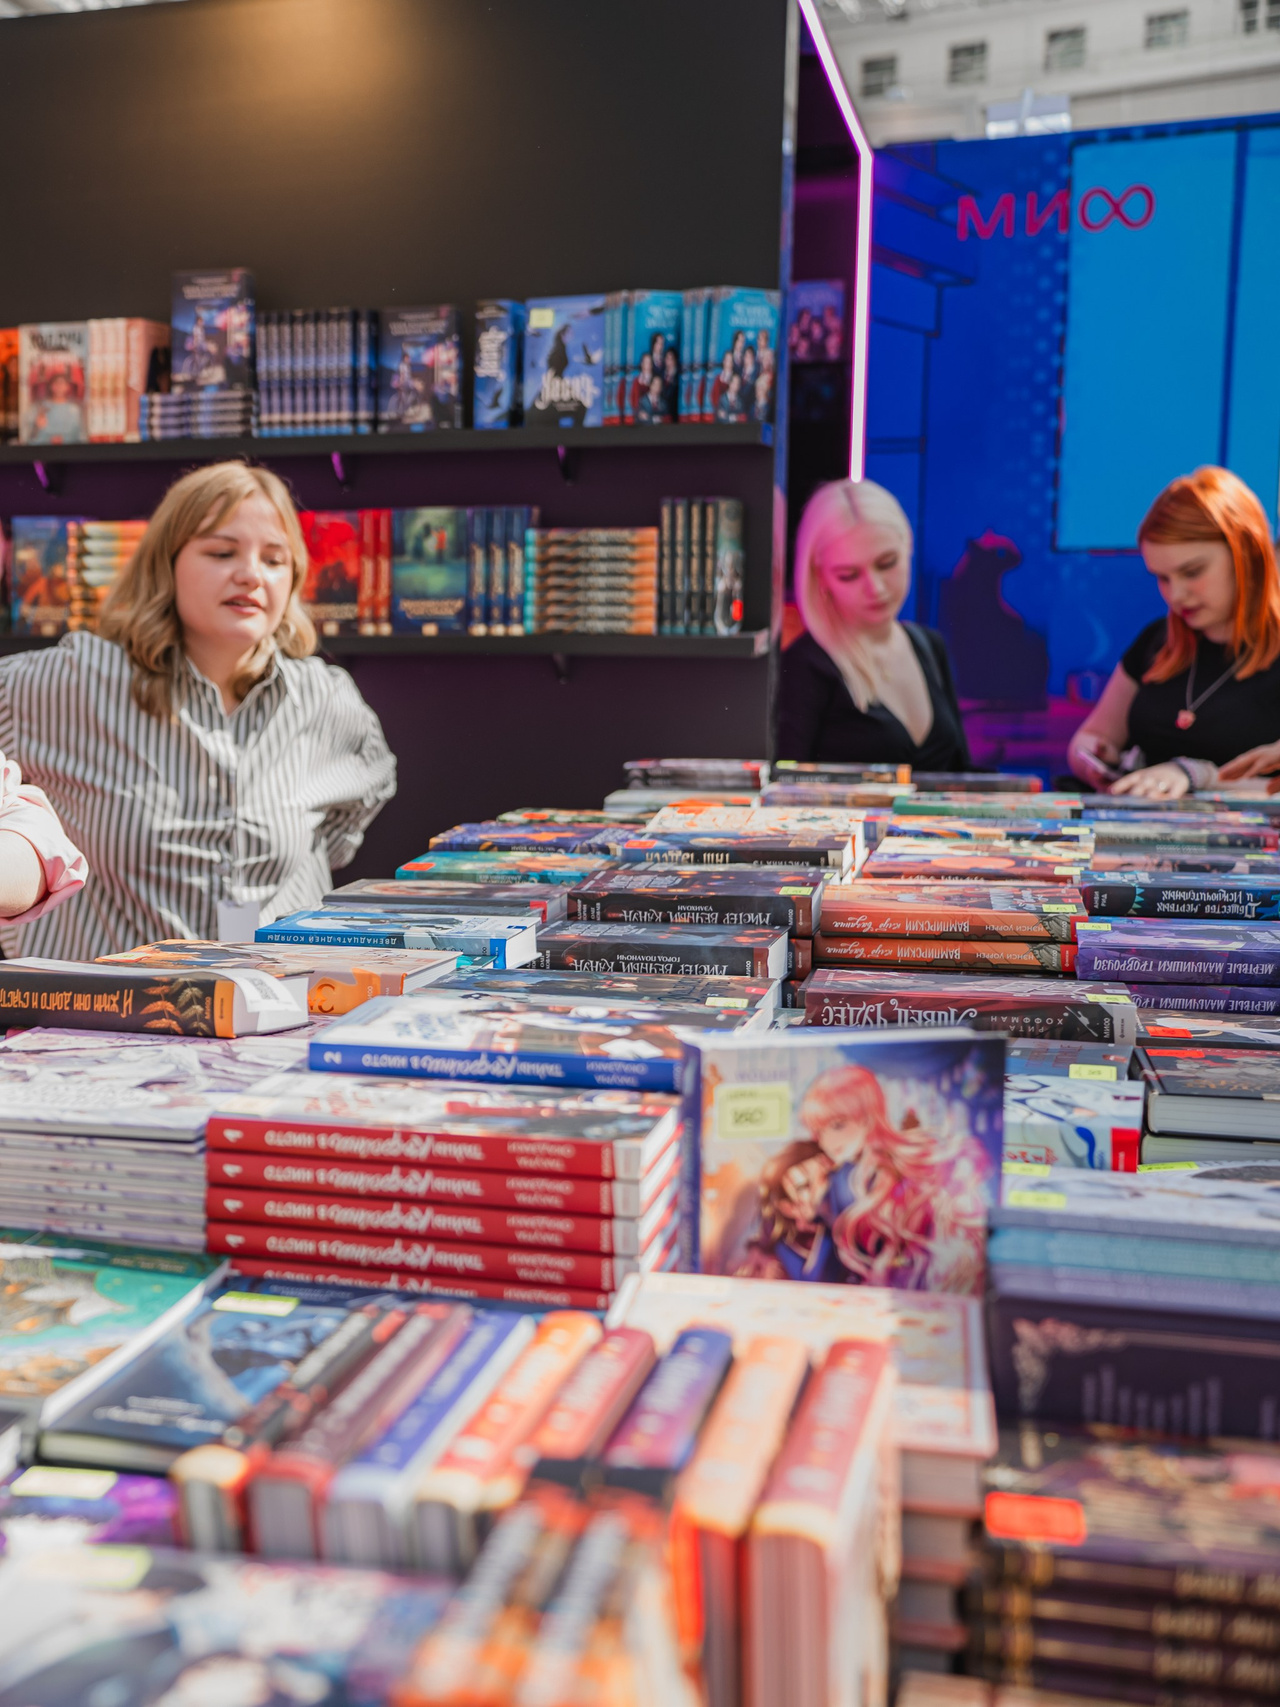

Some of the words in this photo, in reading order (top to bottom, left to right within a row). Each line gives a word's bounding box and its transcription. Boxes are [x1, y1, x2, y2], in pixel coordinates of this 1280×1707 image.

[1161, 889, 1242, 904] Исключительных
[1156, 902, 1200, 915] мертвых
[1204, 901, 1261, 918] Общество
[620, 908, 662, 923] КАНУН
[667, 911, 719, 925] ВЕЧНЫЙ
[723, 912, 771, 926] МИСТЕР
[905, 919, 969, 936] ВАМПИРСКИЙ
[984, 924, 1014, 932] УОРРЕН
[1015, 925, 1044, 933] НЭНСИ
[267, 934, 304, 942] КОЛЯДЫ
[308, 935, 333, 945] ДНЕЙ
[336, 936, 397, 945] ДВЕНАДЦАТЬ
[616, 954, 655, 962] ПОЛУНОЧИ
[658, 955, 680, 963] ГОРОД
[897, 945, 961, 963] ВАМПИРСКИЙ
[974, 951, 1004, 959] УОРРЕН
[1006, 953, 1034, 961] НЭНСИ
[568, 959, 615, 973] КАНУН
[620, 961, 673, 976] ВЕЧНЫЙ
[678, 963, 729, 976] МИСТЕР
[1093, 956, 1154, 972] ТРОВРОУЗА
[1158, 960, 1224, 974] МАЛЬЧИШКИ
[1226, 962, 1274, 975] МЕРТВЫЕ
[31, 992, 38, 1010] И
[40, 991, 72, 1011] ДОЛГО
[73, 993, 91, 1012] ОНИ
[93, 990, 120, 1012] ЖИЛИ
[1160, 997, 1226, 1010] МАЛЬЧИШКИ
[1228, 999, 1275, 1012] МЕРТВЫЕ
[821, 1000, 887, 1028] ЧУДЕС
[889, 998, 978, 1028] ЛОВЕЦ
[989, 1015, 1064, 1026] ХОФФМАН
[1008, 1025, 1045, 1033] РИТА
[324, 1051, 342, 1064] 2
